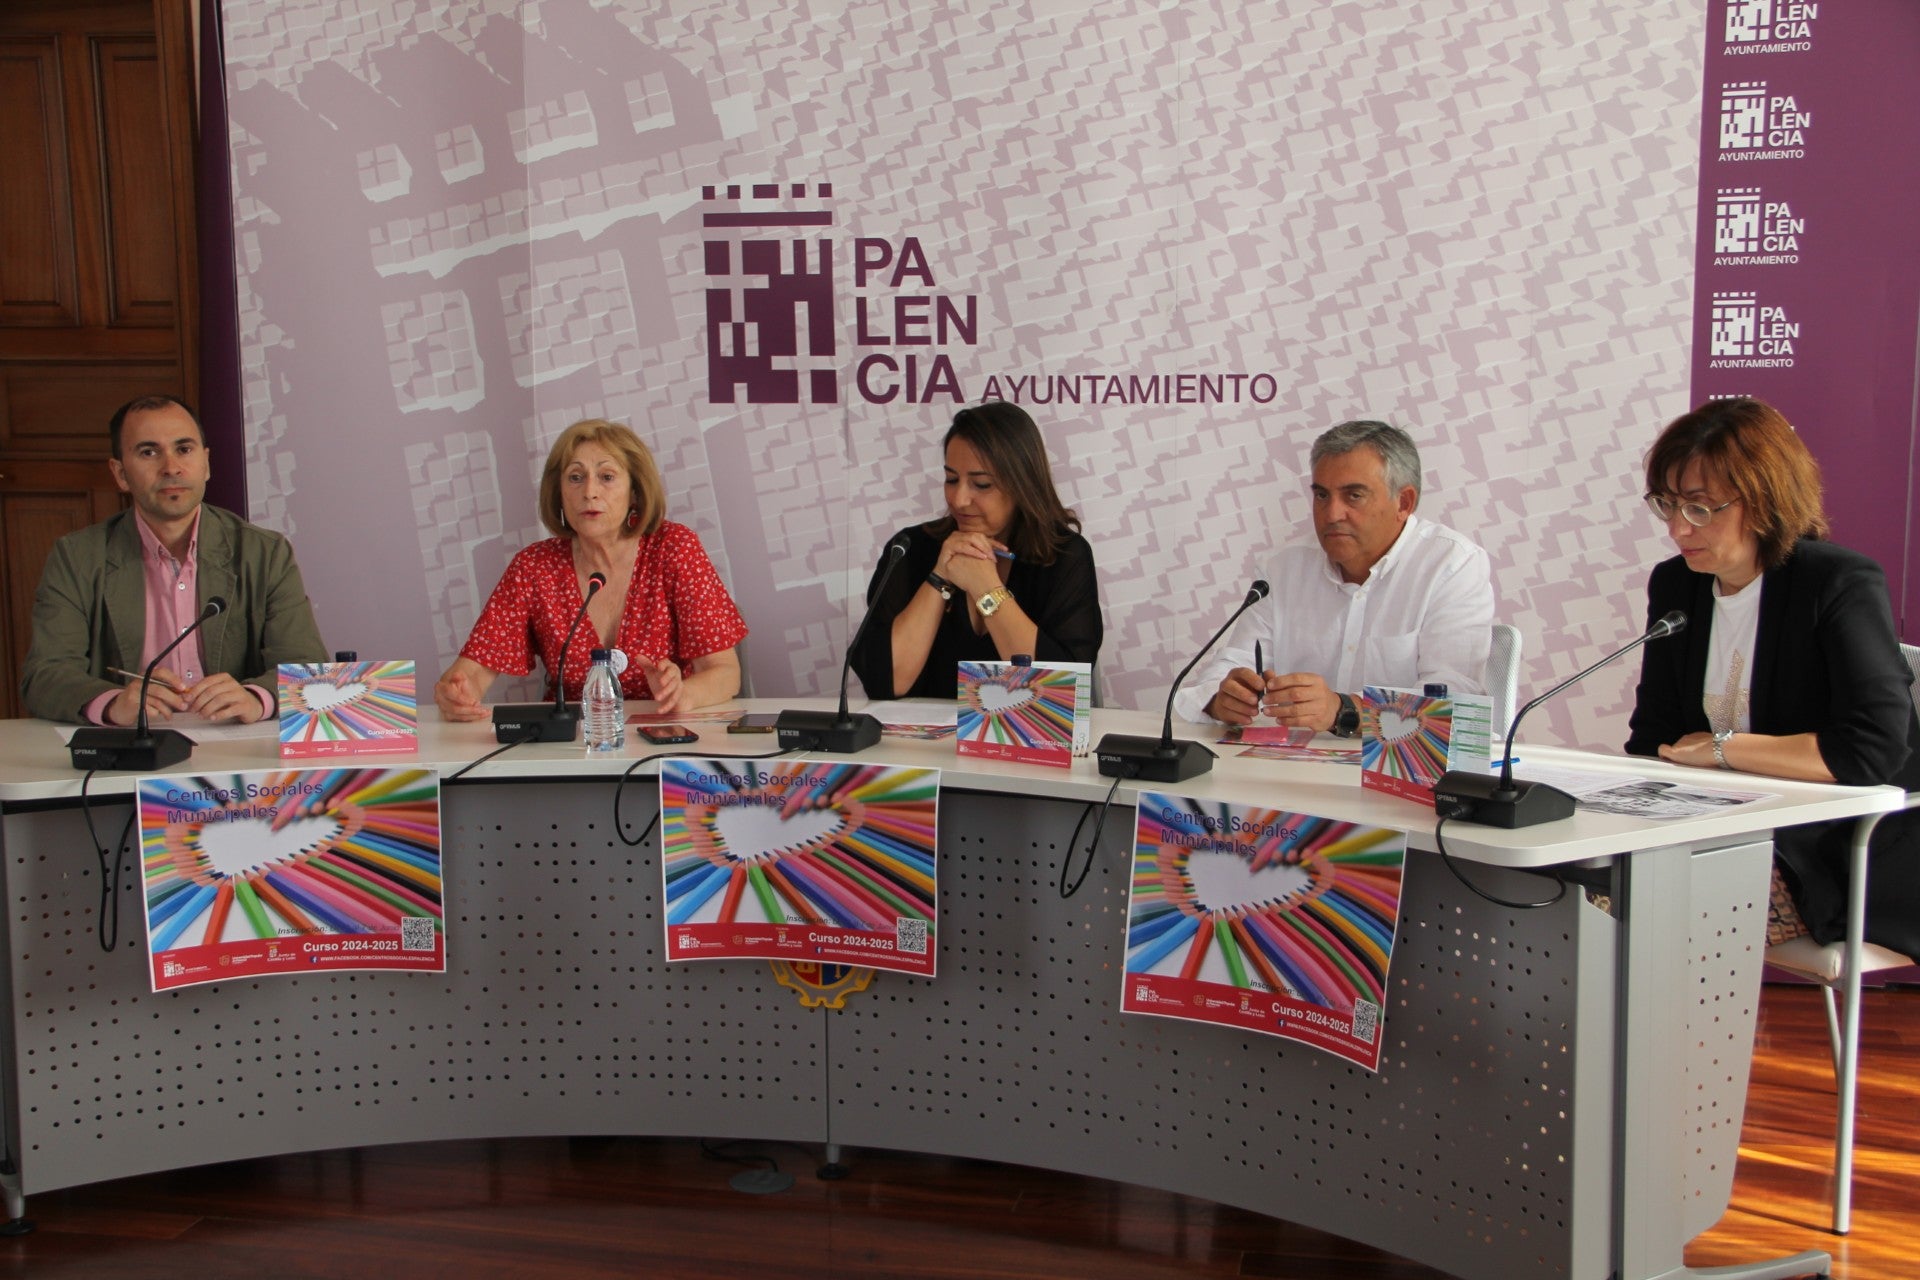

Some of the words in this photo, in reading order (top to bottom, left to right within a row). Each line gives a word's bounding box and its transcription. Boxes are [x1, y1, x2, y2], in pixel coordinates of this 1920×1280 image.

[1776, 3, 1818, 22] LEN
[1774, 22, 1811, 39] CIA
[1724, 42, 1811, 56] AYUNTAMIENTO
[1770, 96, 1797, 113] PA
[1769, 112, 1811, 130] LEN
[1768, 130, 1804, 147] CIA
[1718, 150, 1804, 162] AYUNTAMIENTO
[1764, 202, 1791, 218] PA
[1764, 218, 1804, 235] LEN
[1763, 235, 1798, 252] CIA
[854, 236, 936, 288] PA
[1714, 255, 1798, 266] AYUNTAMIENTO
[855, 295, 977, 346] LEN
[1760, 306, 1786, 322] PA
[1759, 322, 1799, 339] LEN
[1758, 339, 1794, 356] CIA
[1710, 358, 1794, 369] AYUNTAMIENTO
[856, 353, 965, 404] CIA
[980, 373, 1277, 405] AYUNTAMIENTO
[685, 771, 753, 786] Centros
[758, 771, 828, 788] Sociales
[166, 784, 241, 803] Centros
[246, 782, 324, 798] Sociales
[686, 791, 787, 808] Municipales
[167, 805, 279, 824] Municipales
[1161, 806, 1225, 830] Centros
[1230, 816, 1298, 841] Sociales
[1160, 828, 1257, 857] Municipales
[303, 942, 339, 952] Curso
[341, 940, 399, 951] 2024-2025
[808, 932, 841, 944] Curso
[843, 934, 894, 950] 2024-2025
[1272, 1002, 1303, 1019] Curso
[1305, 1010, 1350, 1034] 2024-2025
